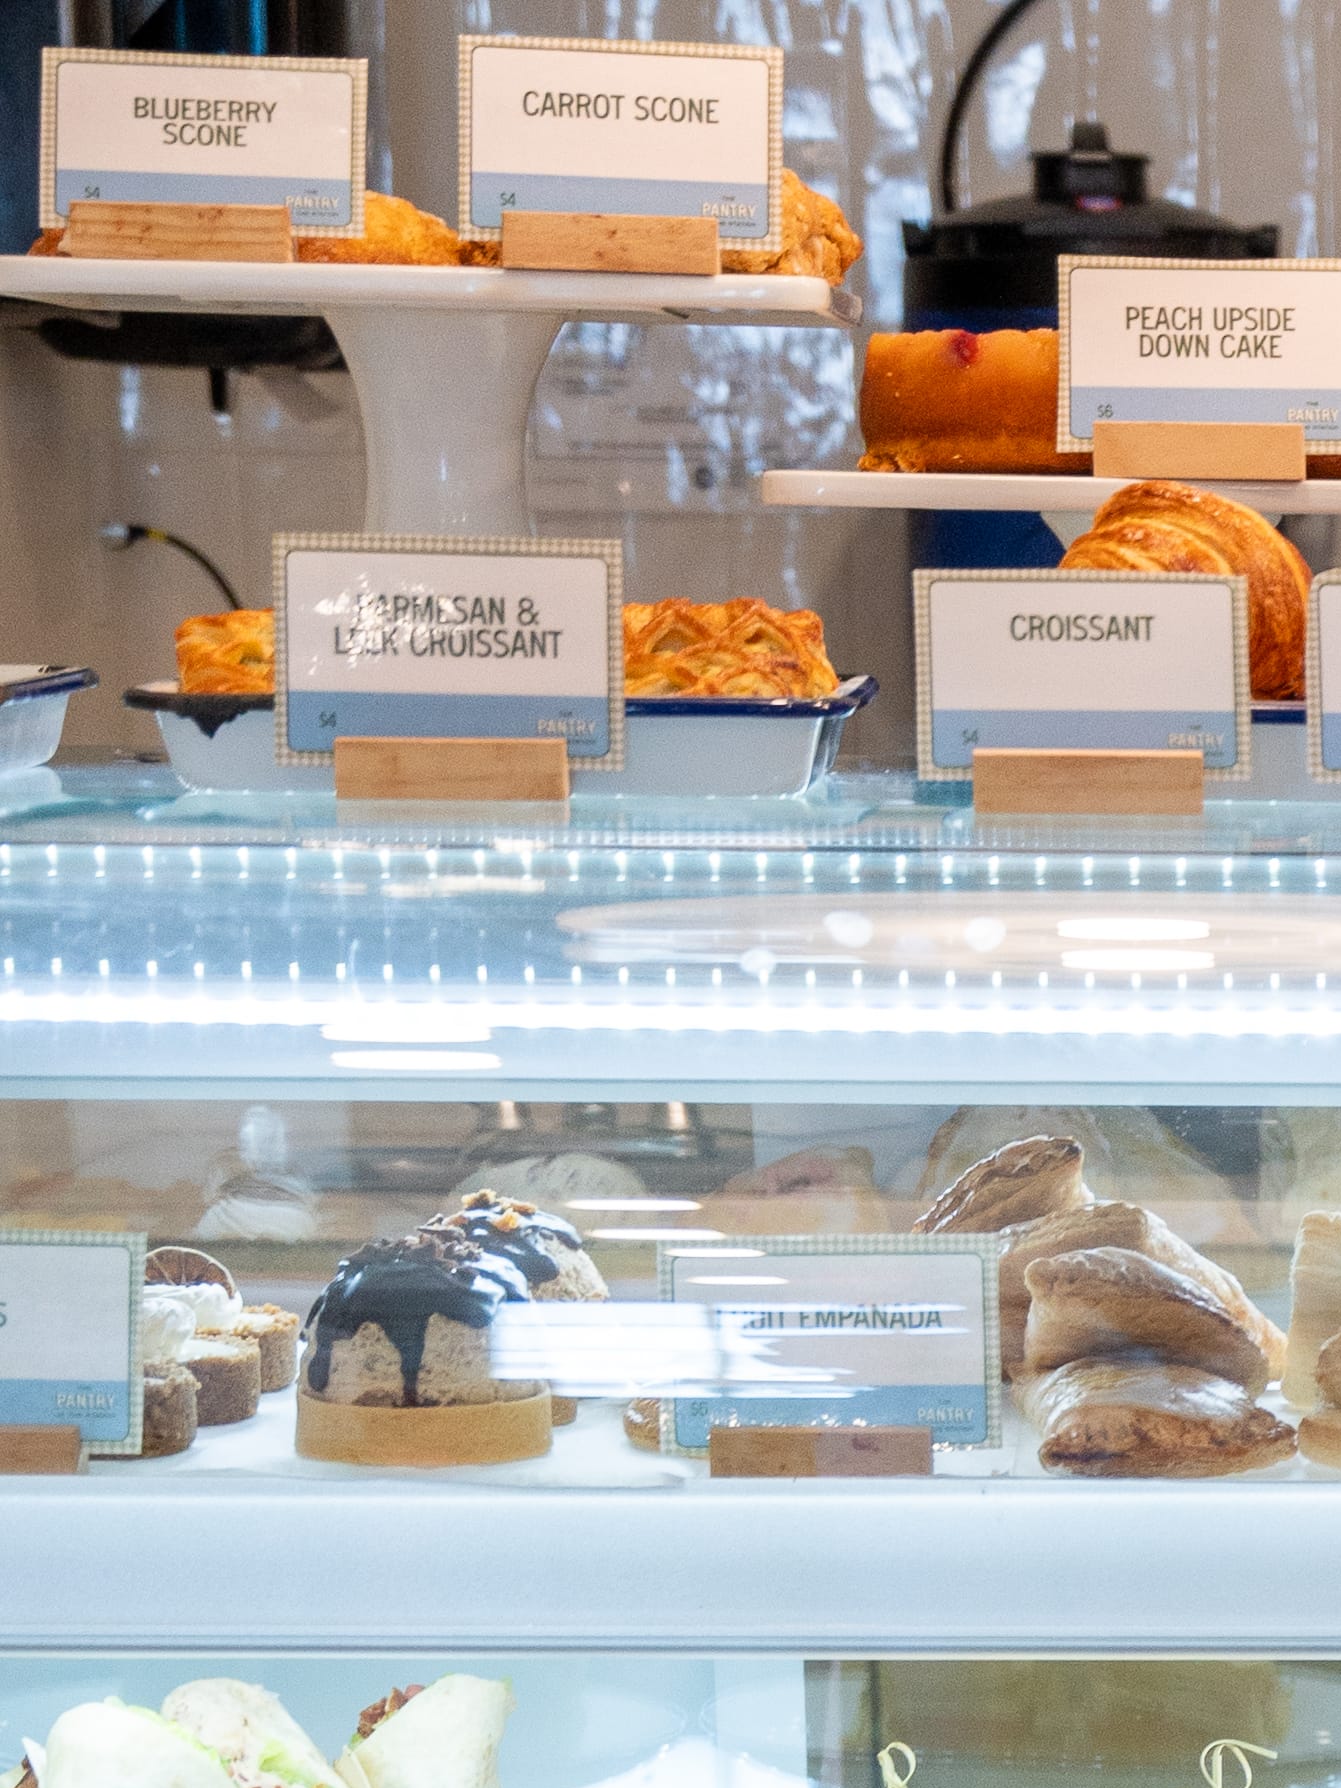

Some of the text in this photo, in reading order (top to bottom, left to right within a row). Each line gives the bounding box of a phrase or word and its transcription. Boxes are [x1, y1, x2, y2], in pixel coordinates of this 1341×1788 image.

[133, 97, 278, 123] BLUEBERRY
[522, 90, 720, 124] CARROT SCONE
[163, 123, 248, 147] SCONE
[702, 203, 756, 219] PANTRY
[1125, 306, 1296, 332] PEACH UPSIDE
[1139, 334, 1283, 359] DOWN CAKE
[1287, 407, 1340, 422] PANTRY
[356, 593, 540, 626] ARMESAN &
[1010, 615, 1155, 642] CROISSANT
[410, 628, 563, 659] CROISSANT
